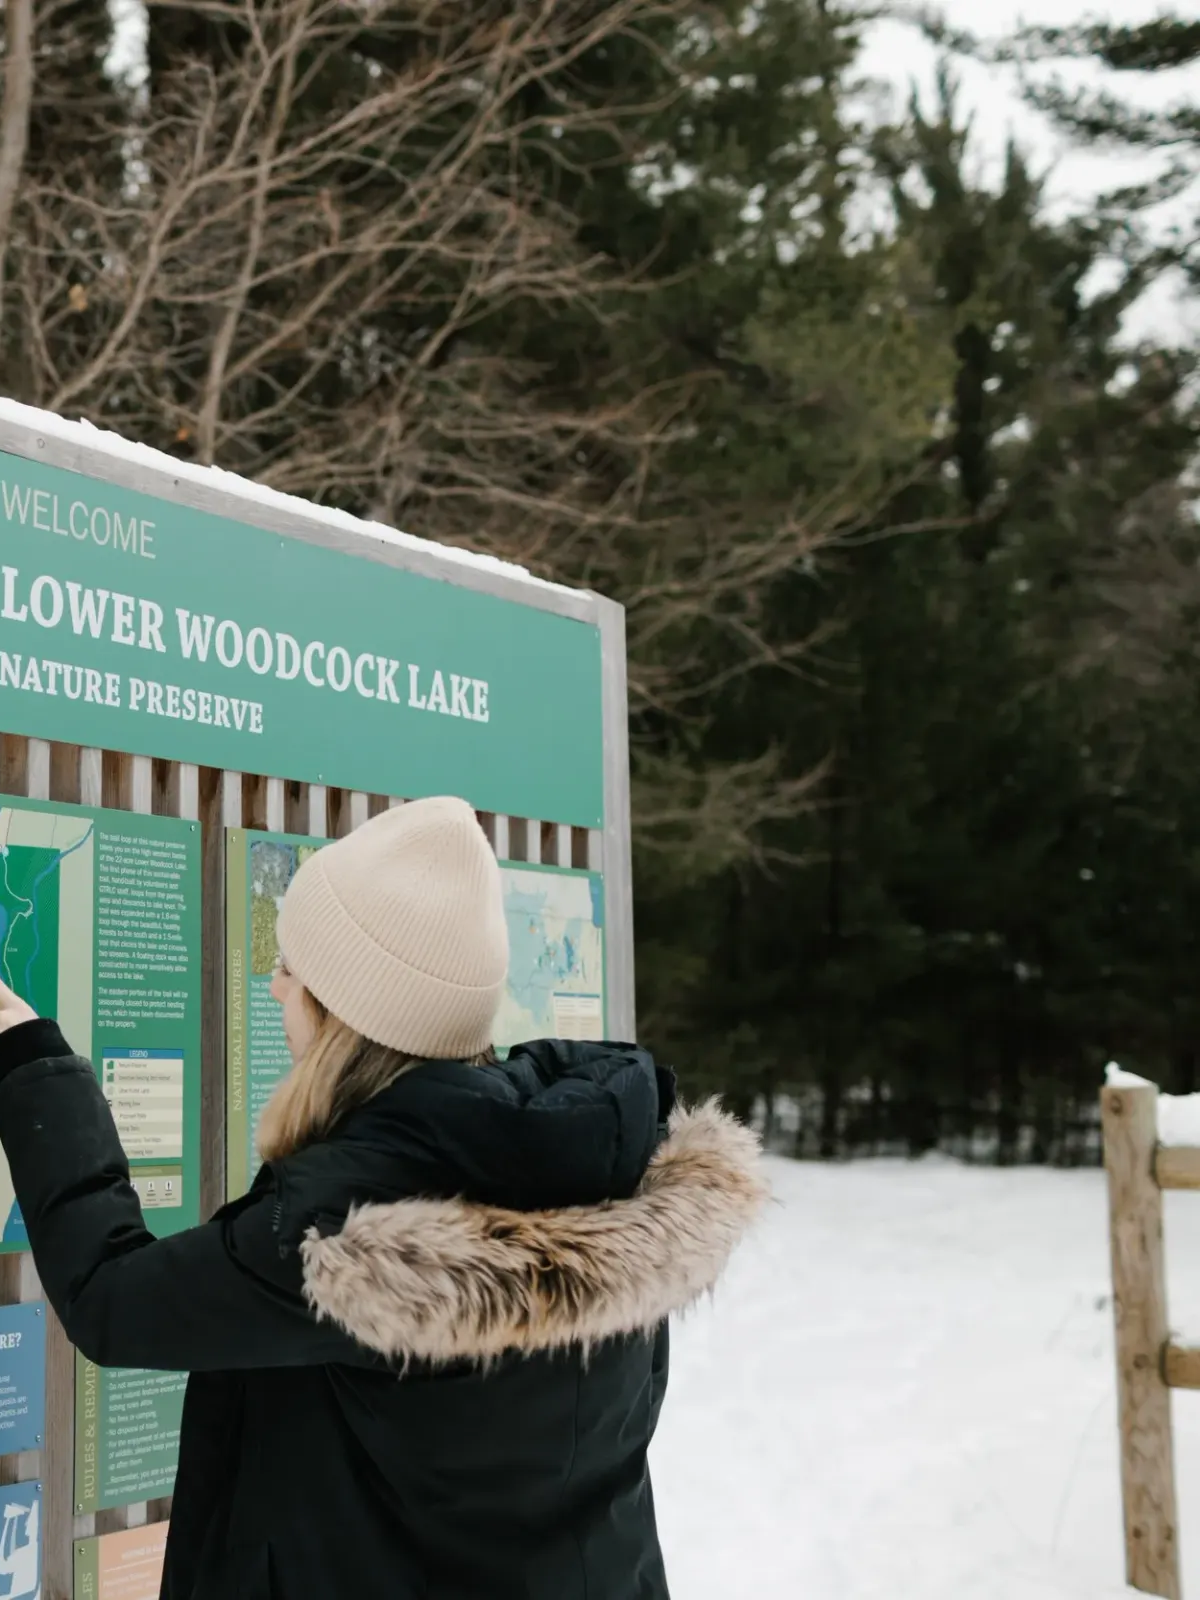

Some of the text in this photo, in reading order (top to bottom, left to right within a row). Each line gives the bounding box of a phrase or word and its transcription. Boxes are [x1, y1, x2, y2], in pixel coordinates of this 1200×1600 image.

[1, 480, 156, 560] WELCOME
[1, 566, 490, 723] LOWER WOODCOCK LAKE
[0, 651, 263, 734] NATURE PRESERVE
[100, 832, 109, 841] The
[121, 836, 131, 844] loop
[98, 987, 108, 995] The
[129, 989, 147, 997] portion
[233, 949, 242, 1111] NATURAL FEATURES
[129, 1050, 148, 1058] LEGEND
[0, 1408, 16, 1419] plants
[17, 1406, 28, 1415] and
[18, 1396, 27, 1404] are
[85, 1360, 96, 1499] RULES & REMIN
